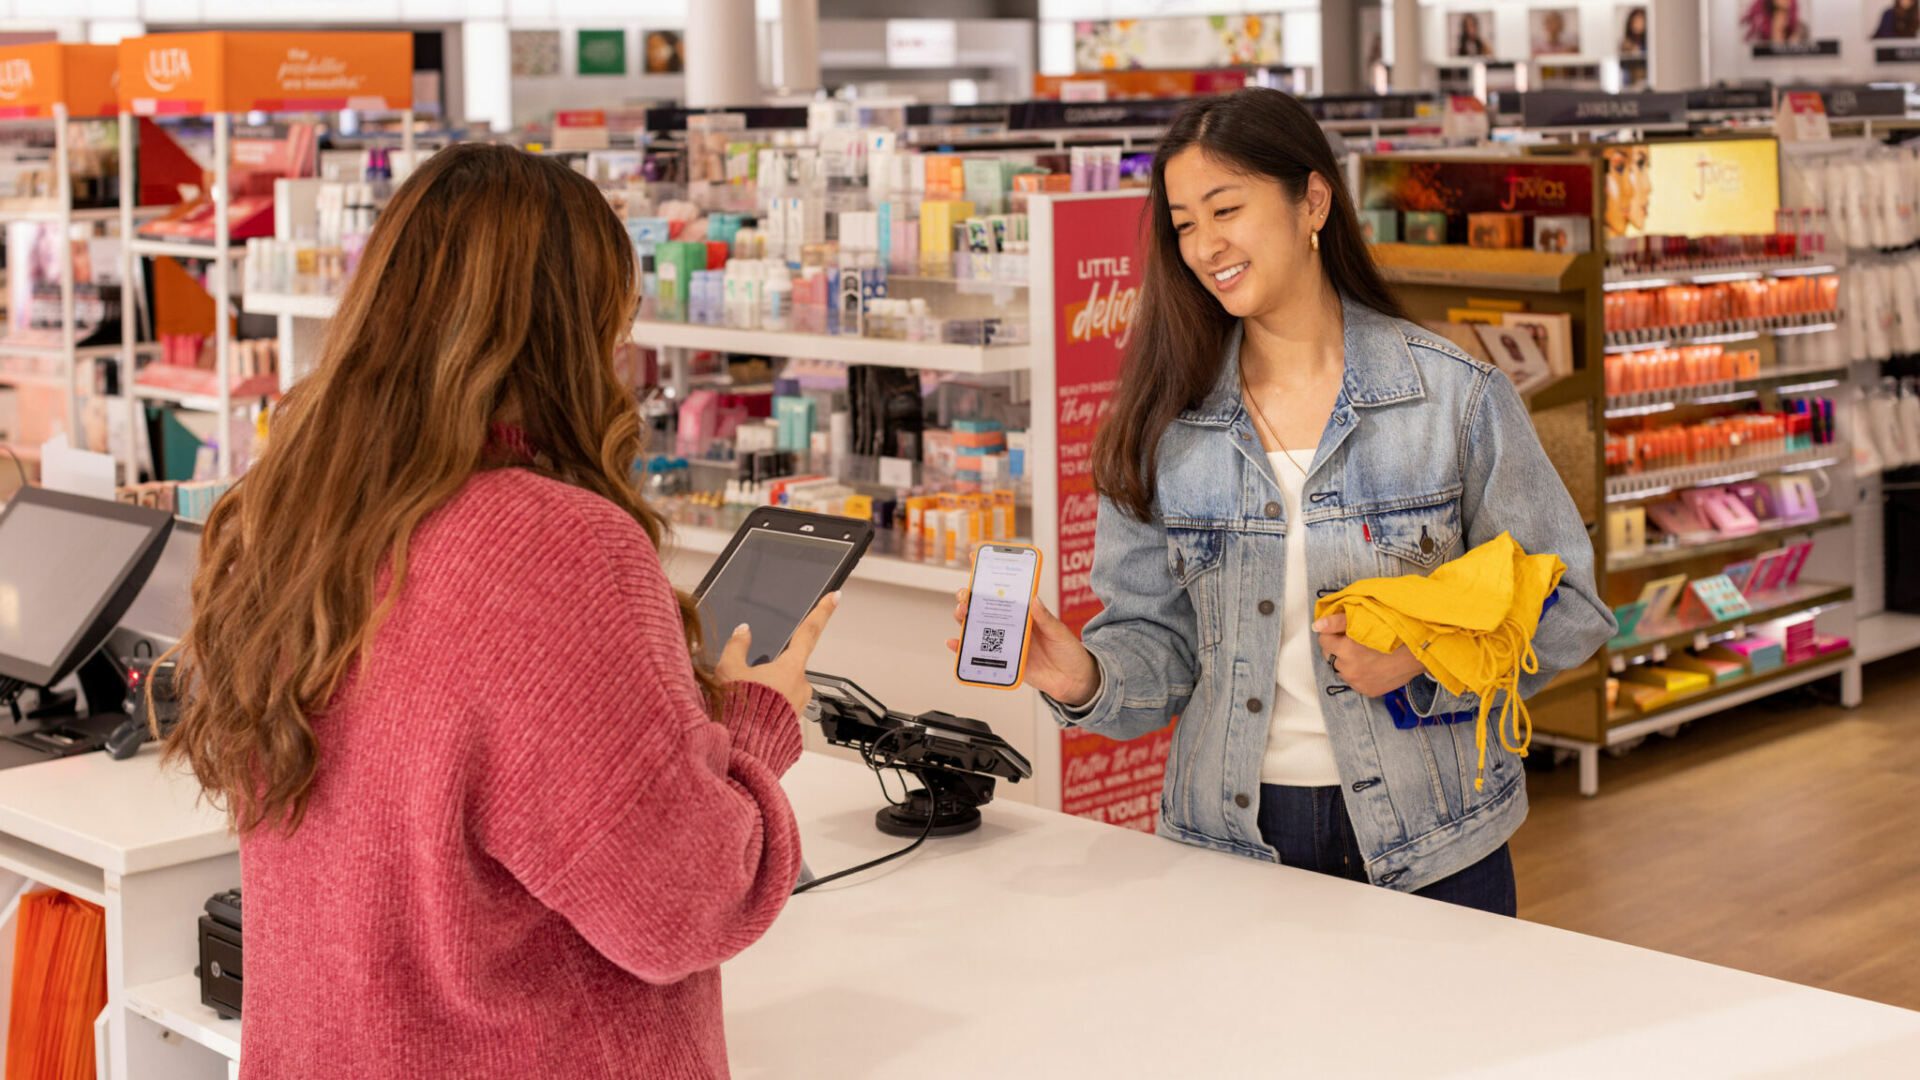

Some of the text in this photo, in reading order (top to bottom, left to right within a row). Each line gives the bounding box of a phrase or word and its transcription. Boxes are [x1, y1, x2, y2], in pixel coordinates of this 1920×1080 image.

[146, 48, 192, 87] ULTA
[1078, 257, 1131, 280] LITTLE
[1072, 280, 1144, 349] delig
[1061, 549, 1093, 572] LOV
[1107, 795, 1149, 824] YOUR
